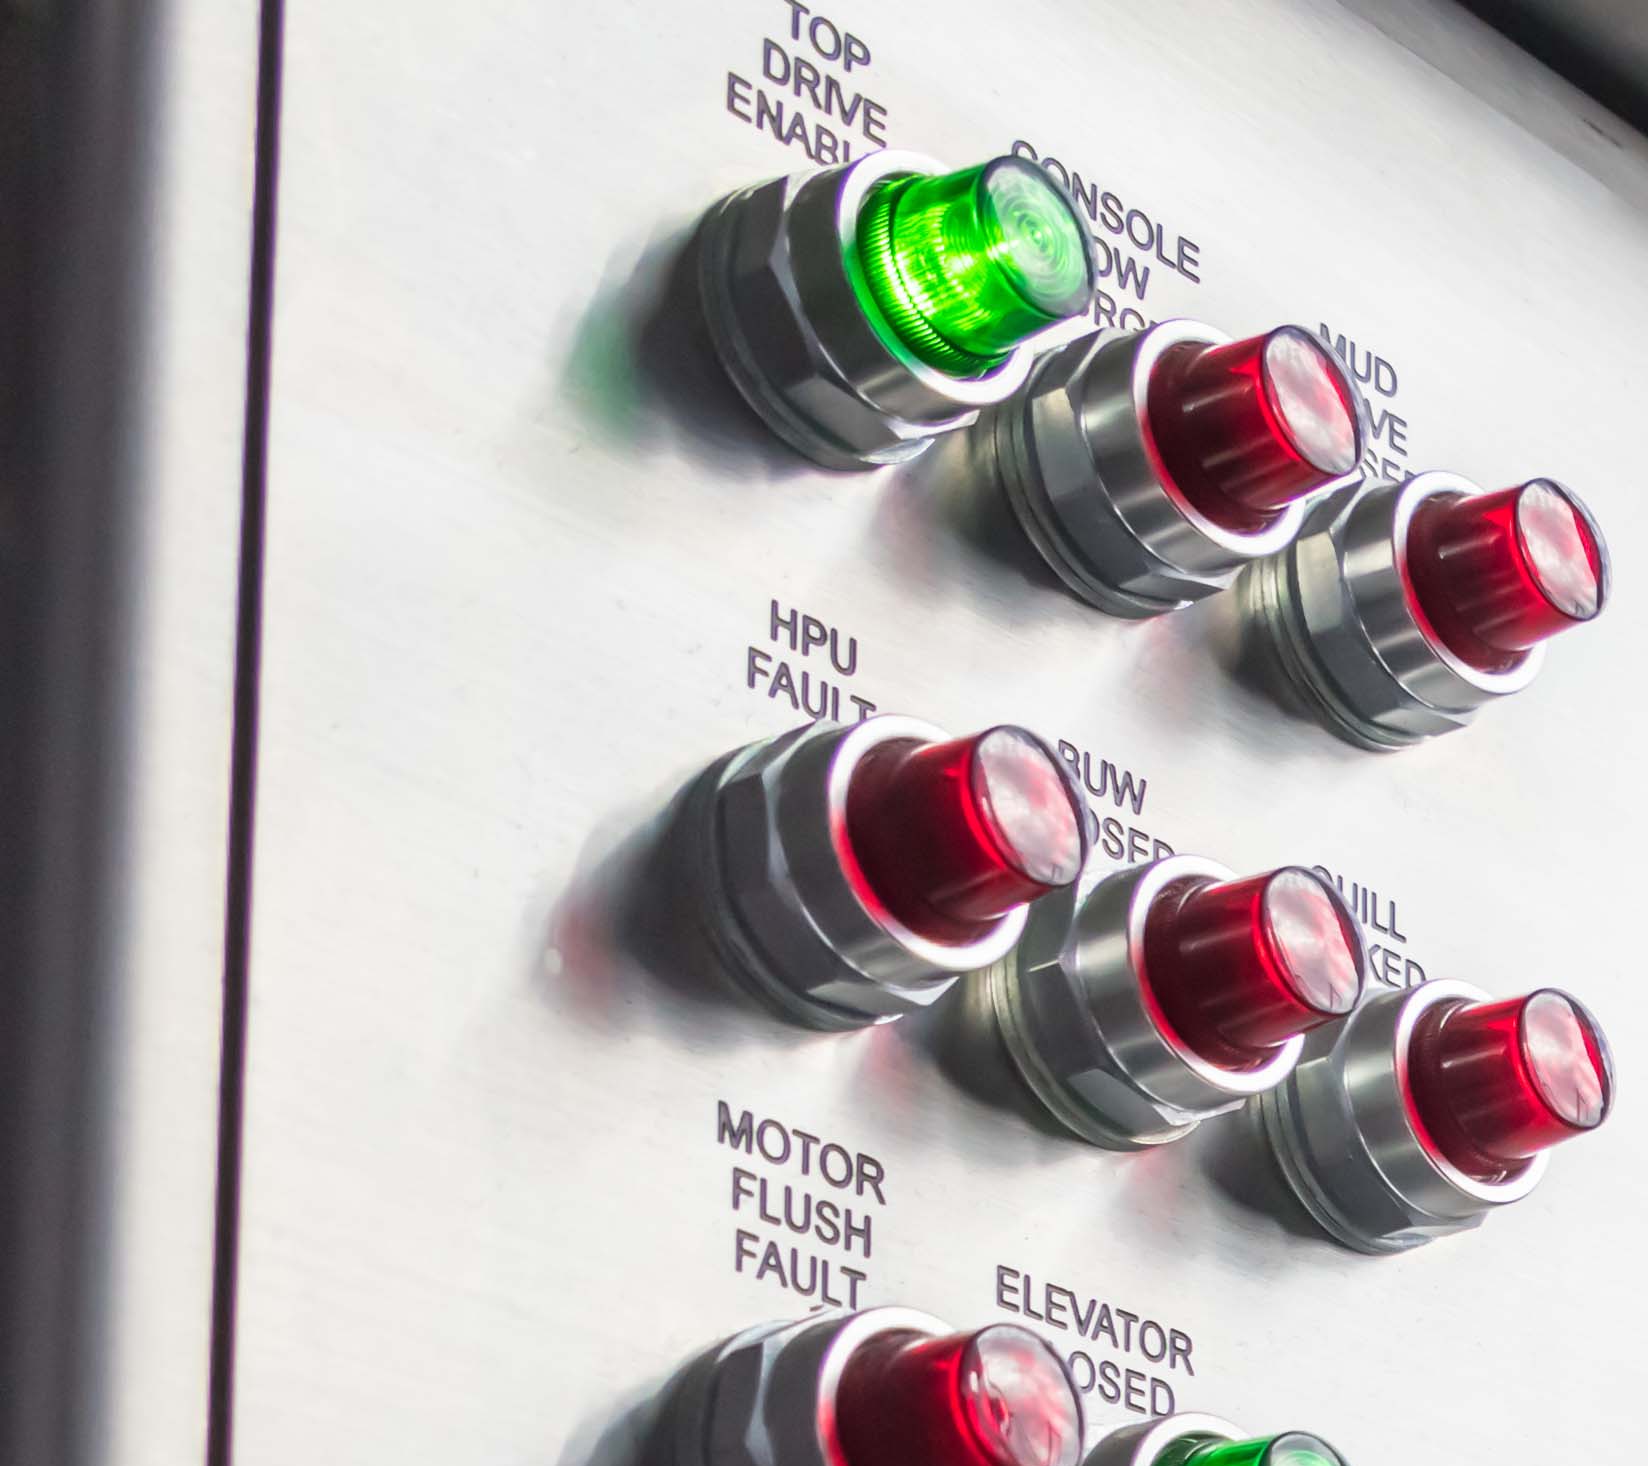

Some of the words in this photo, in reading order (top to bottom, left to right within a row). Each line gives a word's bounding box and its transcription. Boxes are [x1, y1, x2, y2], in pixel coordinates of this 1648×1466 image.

[783, 0, 872, 72] TOP
[762, 37, 888, 149] DRIVE
[1092, 235, 1150, 301] OW
[769, 599, 859, 677] HPU
[716, 1099, 887, 1206] MOTOR
[731, 1165, 872, 1259] FLUSH
[734, 1228, 868, 1312] FAULT
[996, 1264, 1196, 1377] ELEVATOR
[1067, 1350, 1175, 1418] OSED
